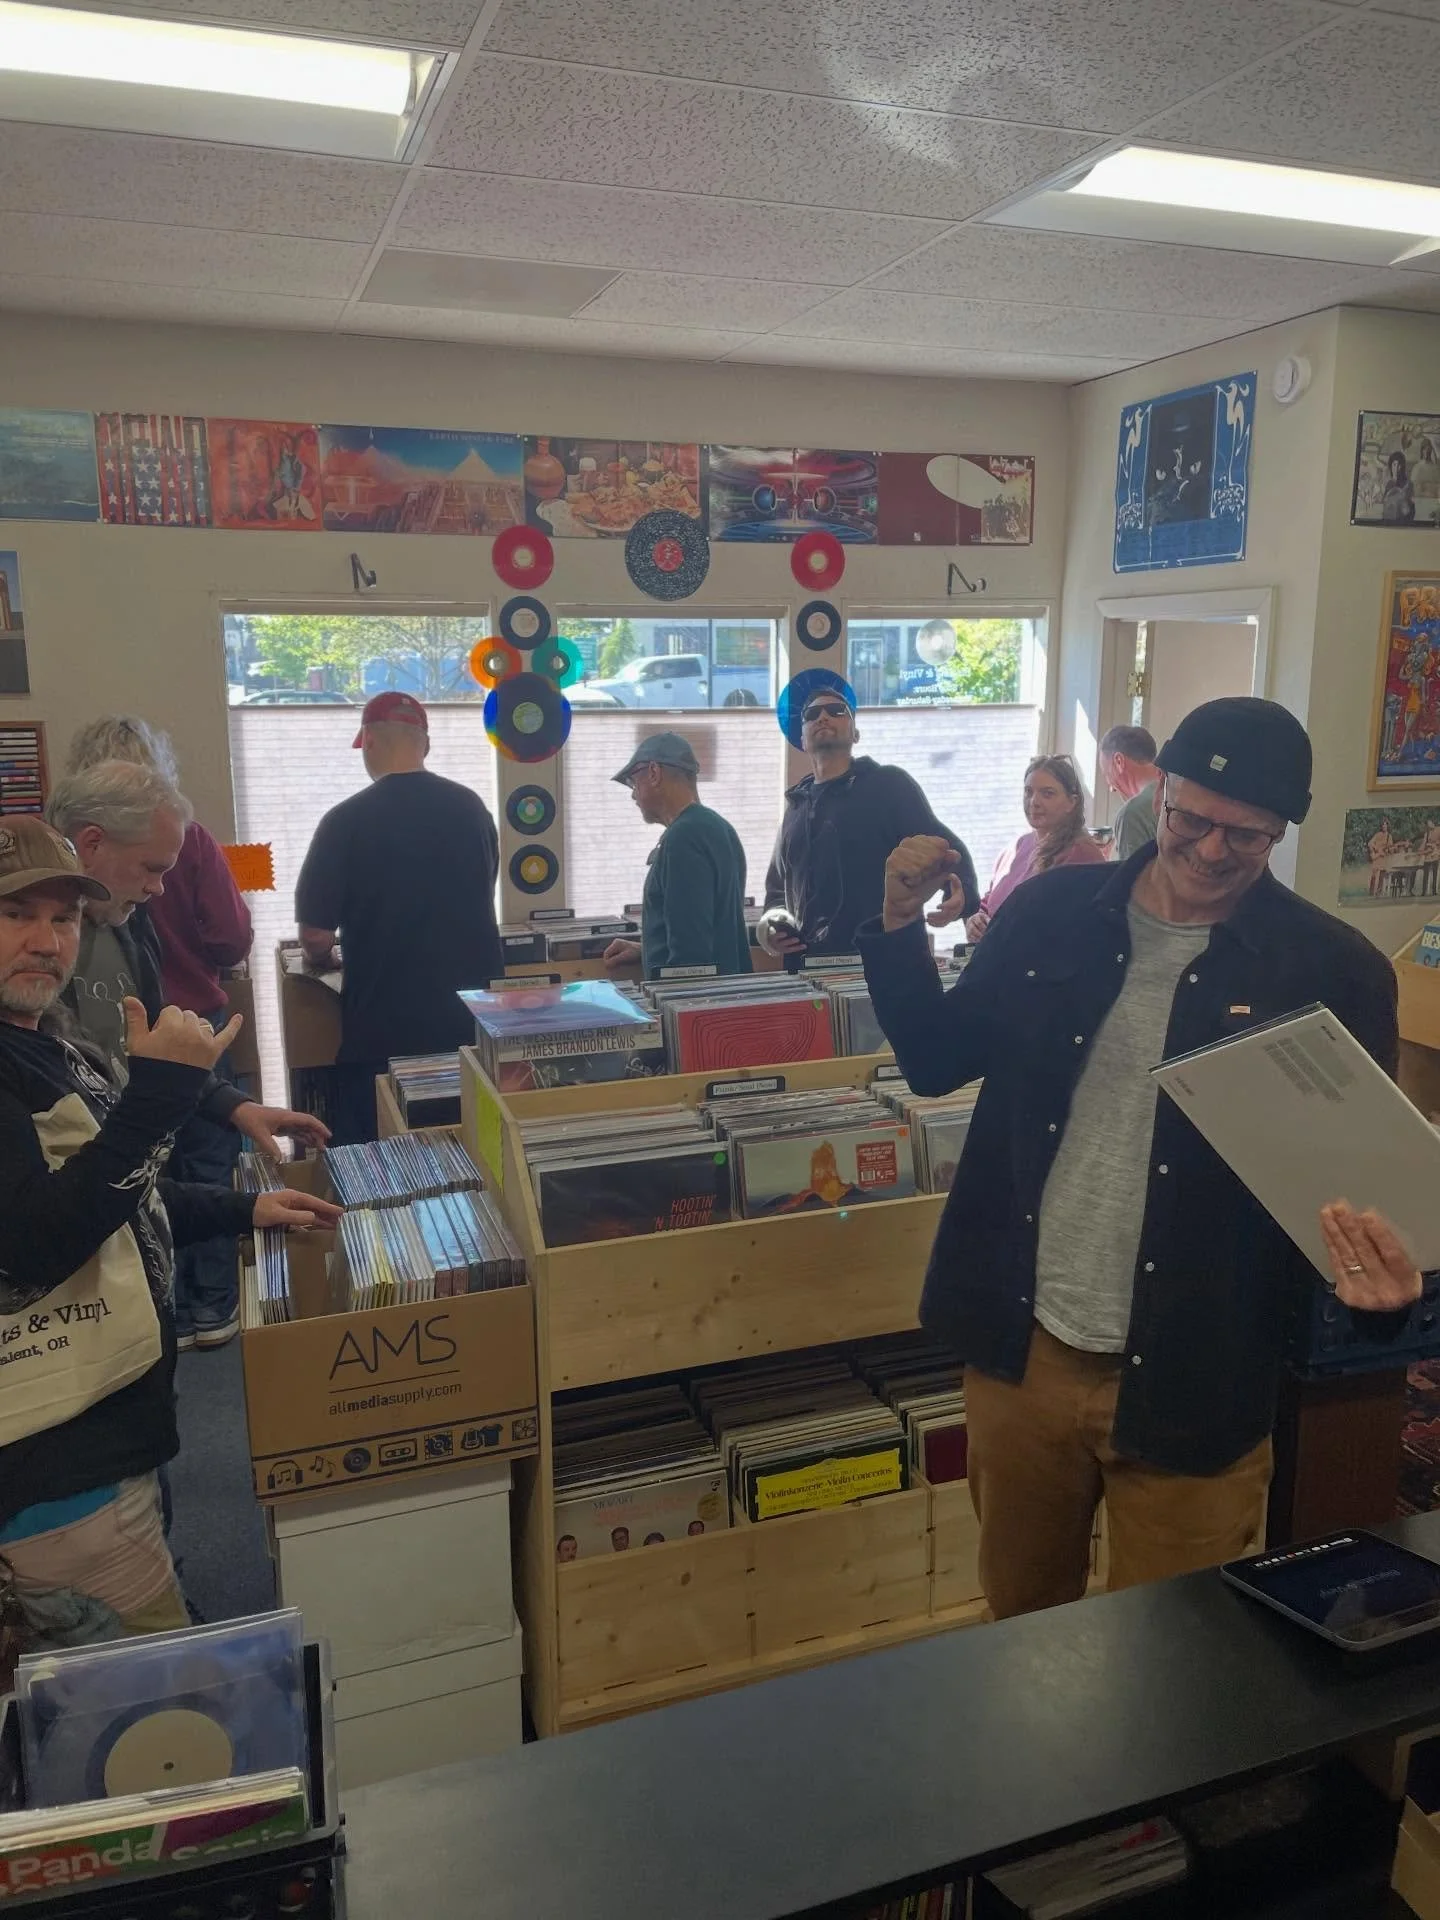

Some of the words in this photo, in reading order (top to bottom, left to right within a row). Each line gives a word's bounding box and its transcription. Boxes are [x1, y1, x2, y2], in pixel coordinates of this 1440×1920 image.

[522, 1044, 554, 1059] JAMES
[556, 1038, 604, 1056] BRANDON
[606, 1034, 636, 1050] LEWIS
[28, 1313, 50, 1334] &
[53, 1297, 112, 1324] Vinyl
[0, 1344, 43, 1366] alent,
[47, 1335, 71, 1351] OR
[328, 1313, 458, 1382] AMS
[328, 1382, 463, 1417] allmediasupply.com
[8, 1838, 152, 1886] Panda
